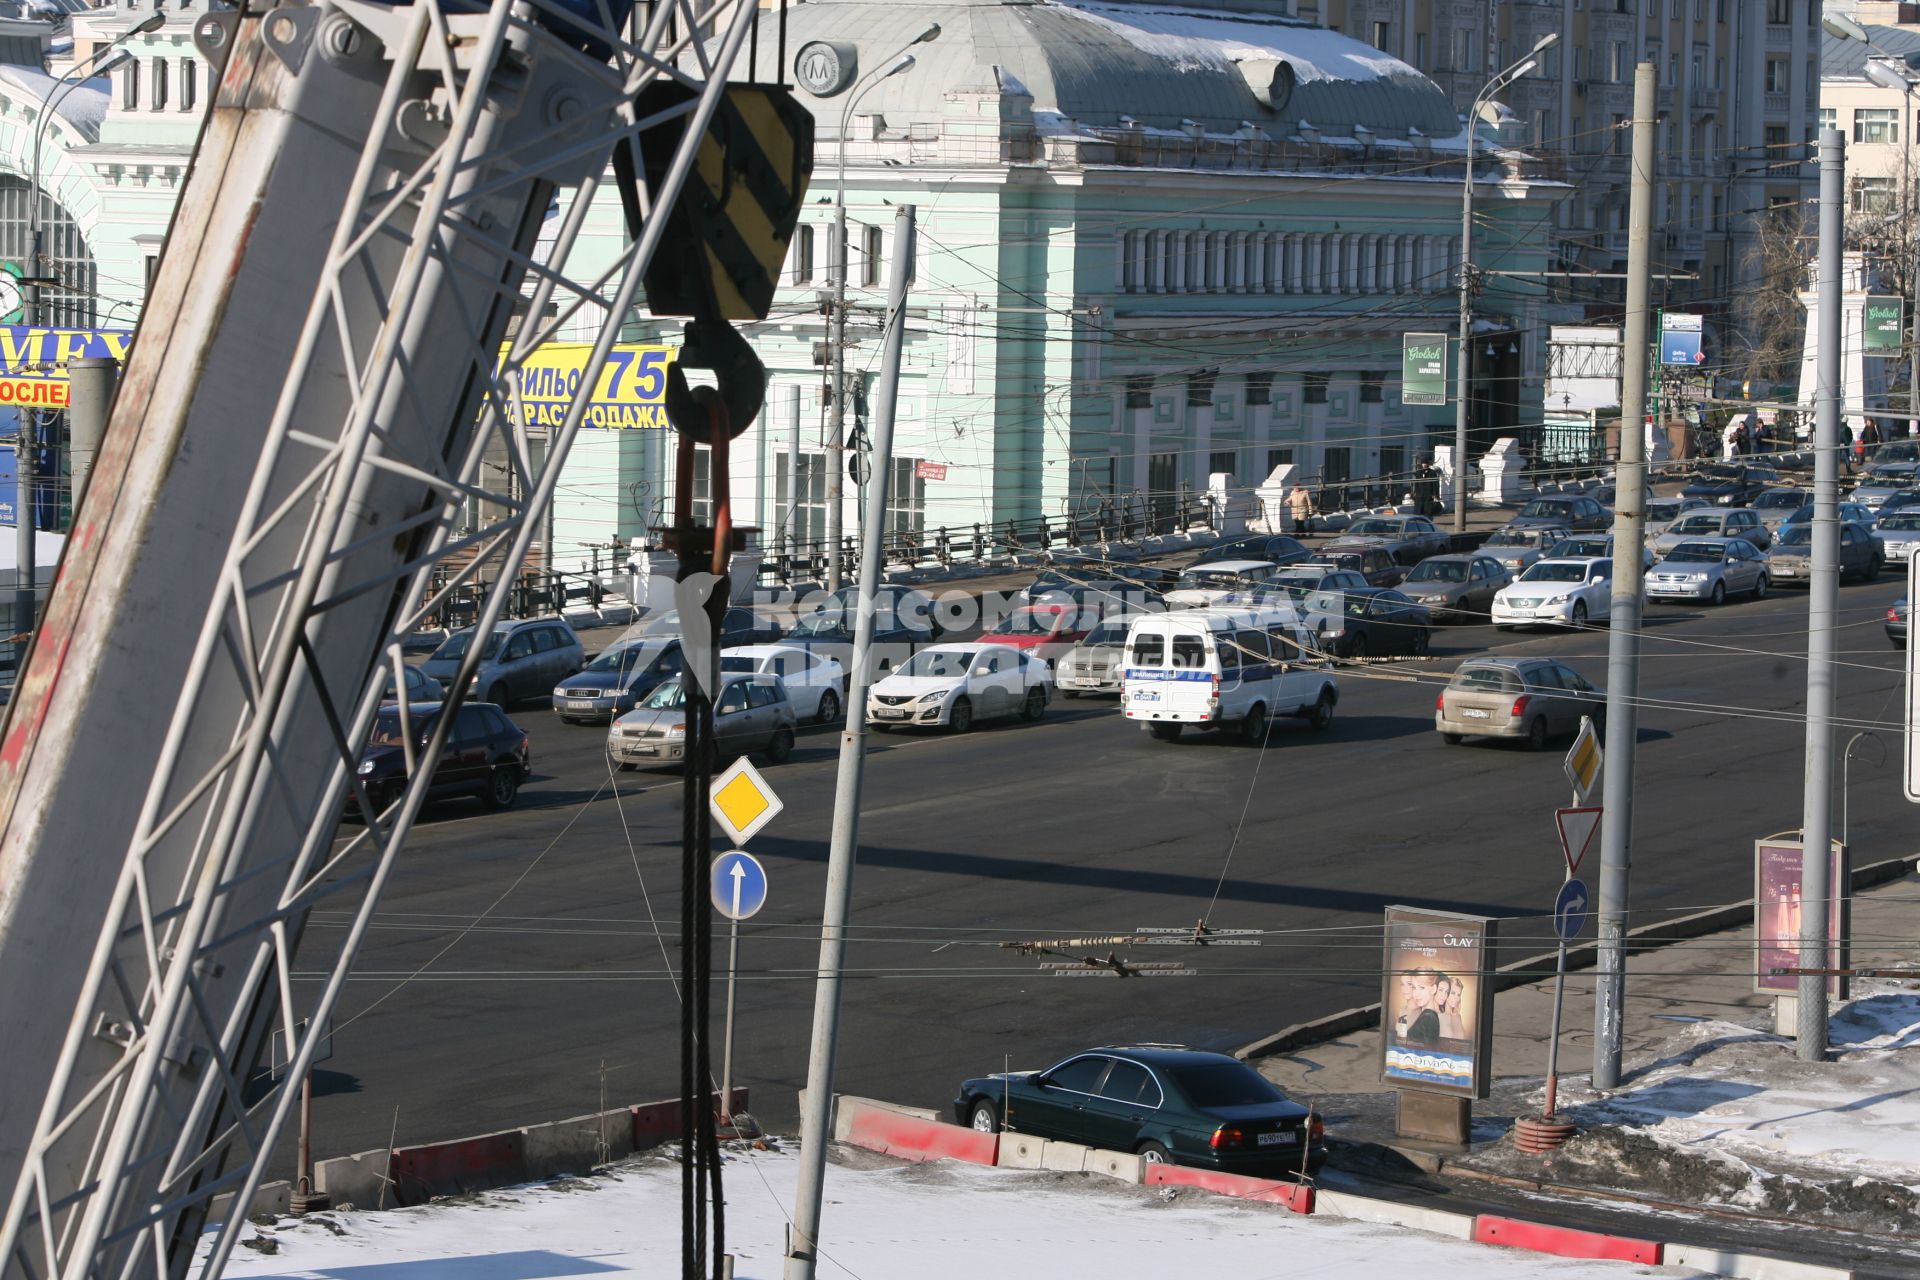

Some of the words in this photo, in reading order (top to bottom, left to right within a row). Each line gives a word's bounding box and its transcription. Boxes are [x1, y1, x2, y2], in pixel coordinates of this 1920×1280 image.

[608, 351, 667, 399] 75
[0, 381, 71, 406] ОСЛЕ
[525, 404, 670, 429] РАСРОДАЖА
[1443, 933, 1473, 948] OLAY
